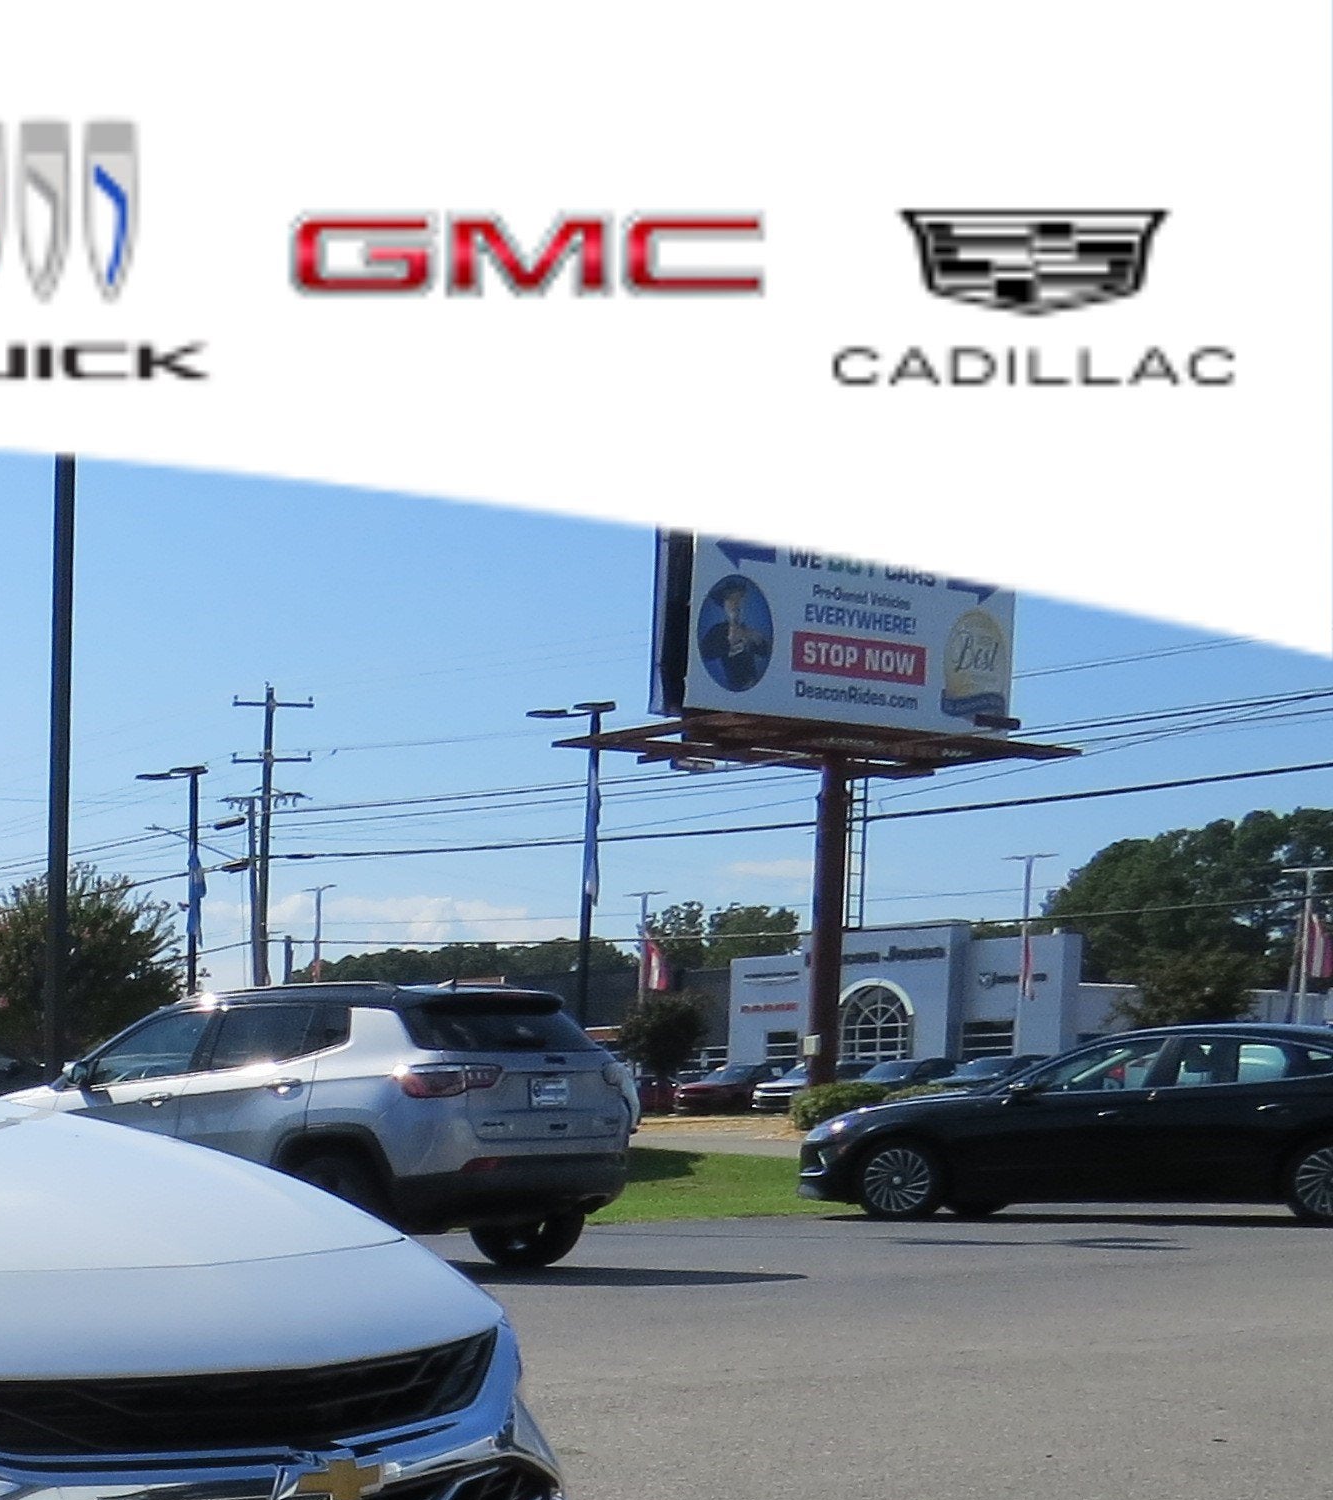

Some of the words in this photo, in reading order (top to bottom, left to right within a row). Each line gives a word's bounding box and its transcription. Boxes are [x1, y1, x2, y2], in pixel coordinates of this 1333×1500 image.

[804, 603, 917, 636] EVERYWHERE!
[802, 640, 858, 668] STOP
[865, 649, 916, 676] NOW
[794, 680, 919, 710] DeaconRides.com
